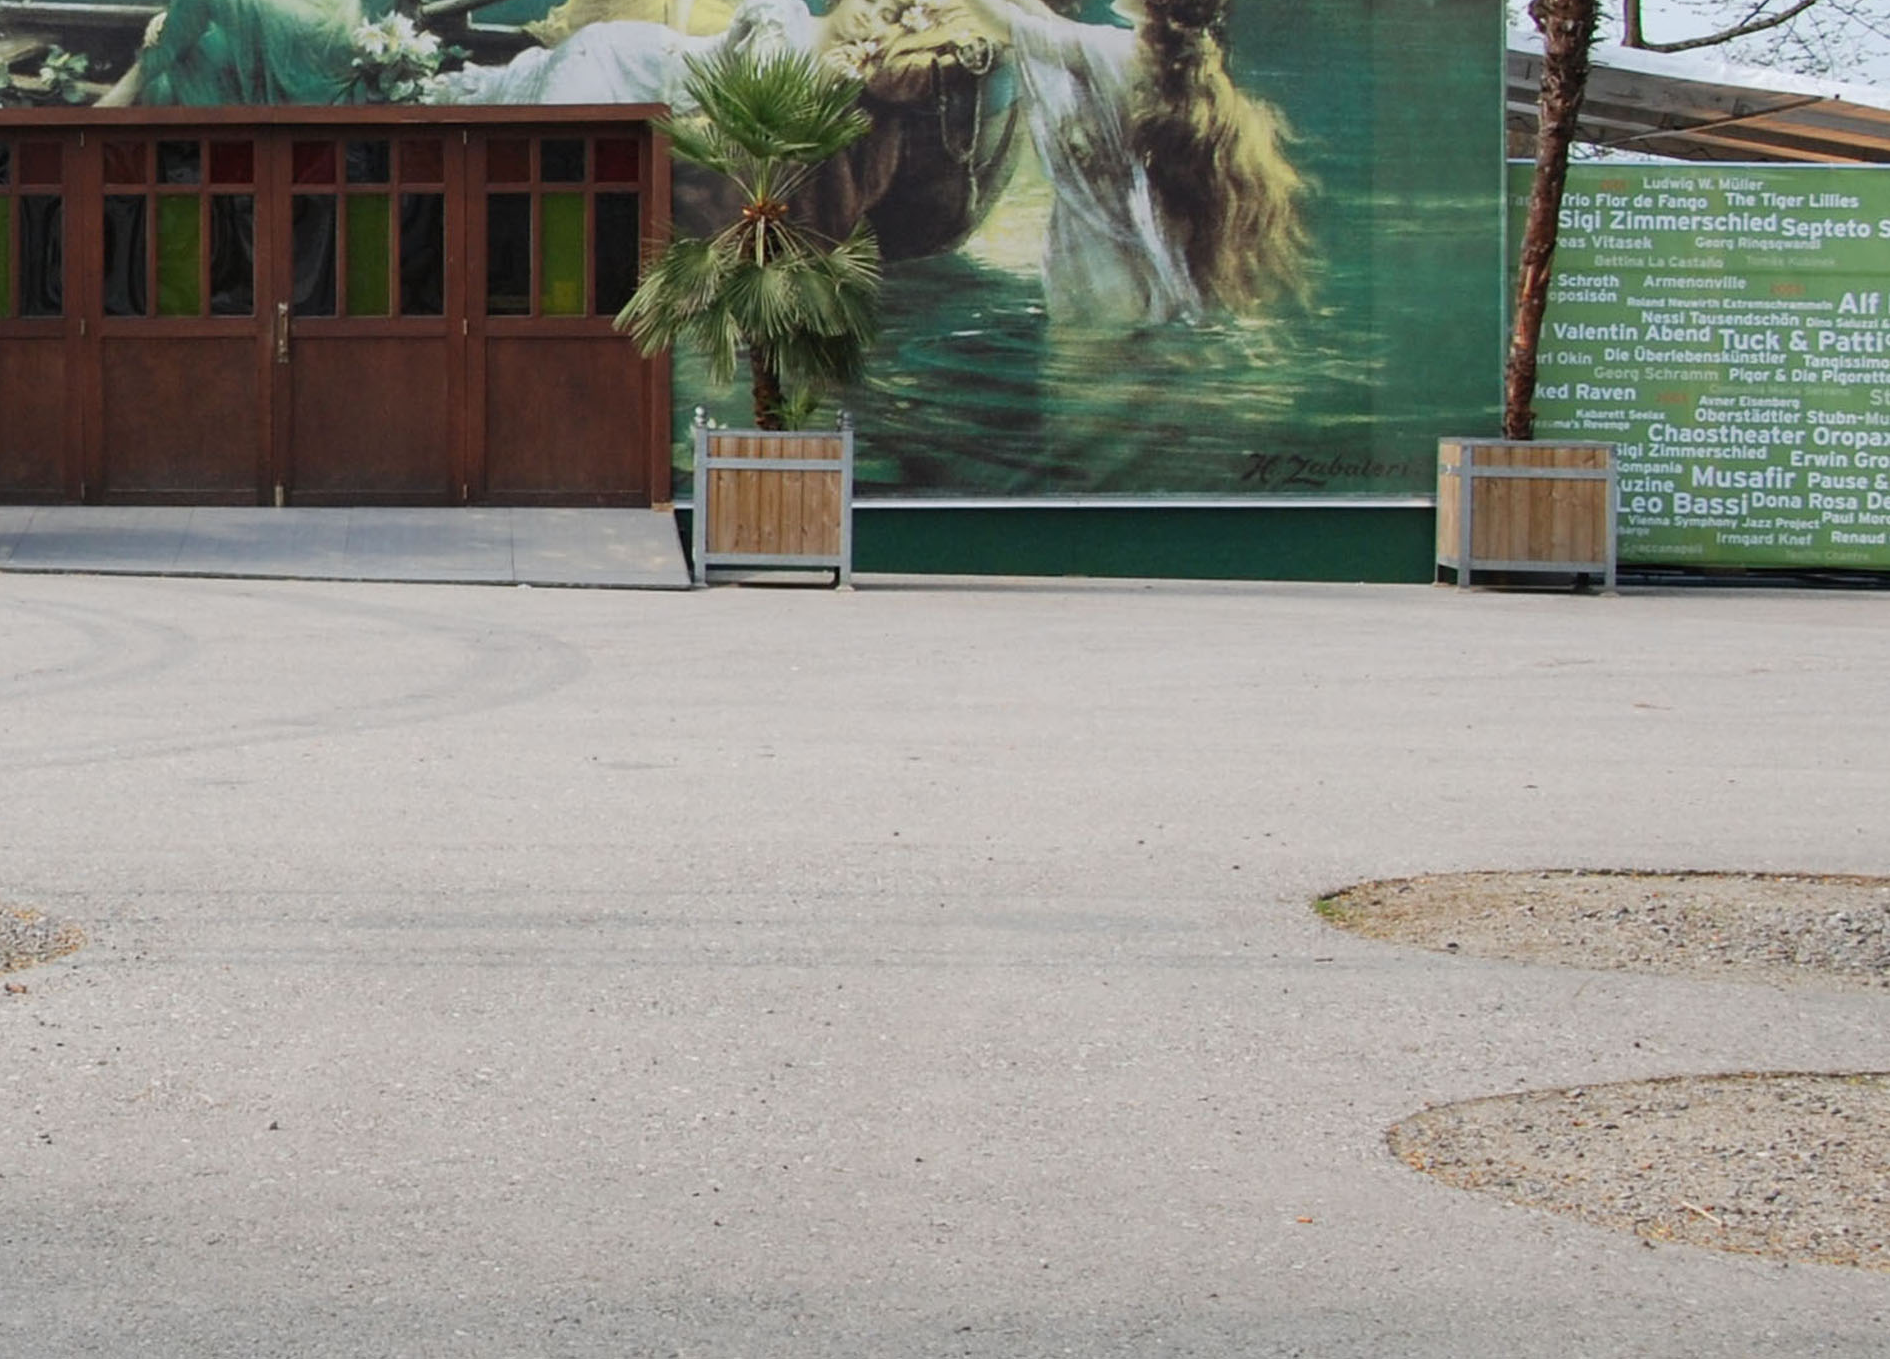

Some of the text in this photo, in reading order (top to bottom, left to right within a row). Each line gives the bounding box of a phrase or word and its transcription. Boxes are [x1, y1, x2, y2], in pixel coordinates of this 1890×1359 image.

[1643, 177, 1693, 191] Ludwig
[1698, 178, 1714, 190] W.
[1719, 178, 1764, 191] Müller
[1595, 193, 1628, 207] Flor
[1633, 194, 1653, 208] de
[1658, 194, 1708, 211] Fango
[1725, 192, 1860, 210] The Tiger Lillies
[1558, 209, 1777, 233] Sigi Zimmerschied
[1781, 217, 1871, 241] Septeto
[1591, 235, 1652, 249] Vitasek
[1695, 236, 1734, 251] Georg
[1594, 254, 1644, 267] Bettina
[1648, 254, 1665, 268] La
[1558, 273, 1619, 288] Schroth
[1643, 274, 1747, 290] Armenonville
[1838, 291, 1880, 315] Alf
[1641, 311, 1800, 327] Nessi Tausendschön
[1806, 316, 1832, 328] Dino
[1553, 322, 1638, 341] Valentin
[1645, 323, 1711, 343] Abend
[1719, 328, 1884, 353] Tuck & Patti
[1557, 351, 1593, 365] Okin
[1604, 345, 1787, 364] Die Überlebenskünstler
[1594, 366, 1718, 382] Georg Schramm
[1729, 367, 1771, 384] Pigor
[1774, 369, 1787, 383] &
[1791, 369, 1817, 382] Die
[1576, 383, 1636, 401] Raven
[1739, 396, 1800, 409] Eisenberg
[1576, 409, 1625, 419] Kabarett
[1694, 408, 1802, 423] Oberstädtler
[1648, 423, 1806, 445] Chaostheater
[1648, 443, 1768, 460] Zimmerschied
[1790, 450, 1848, 467] Erwin
[1692, 465, 1889, 490] Musafir Pause &
[1617, 489, 1663, 514] Leo
[1673, 492, 1748, 516] Bassi
[1752, 491, 1802, 509] Dona
[1808, 492, 1858, 510] Rosa
[1628, 515, 1820, 531] Vienna Symphony Jazz Project
[1822, 511, 1854, 524] Paul
[1716, 531, 1885, 547] Irmgard Knef Renaud
